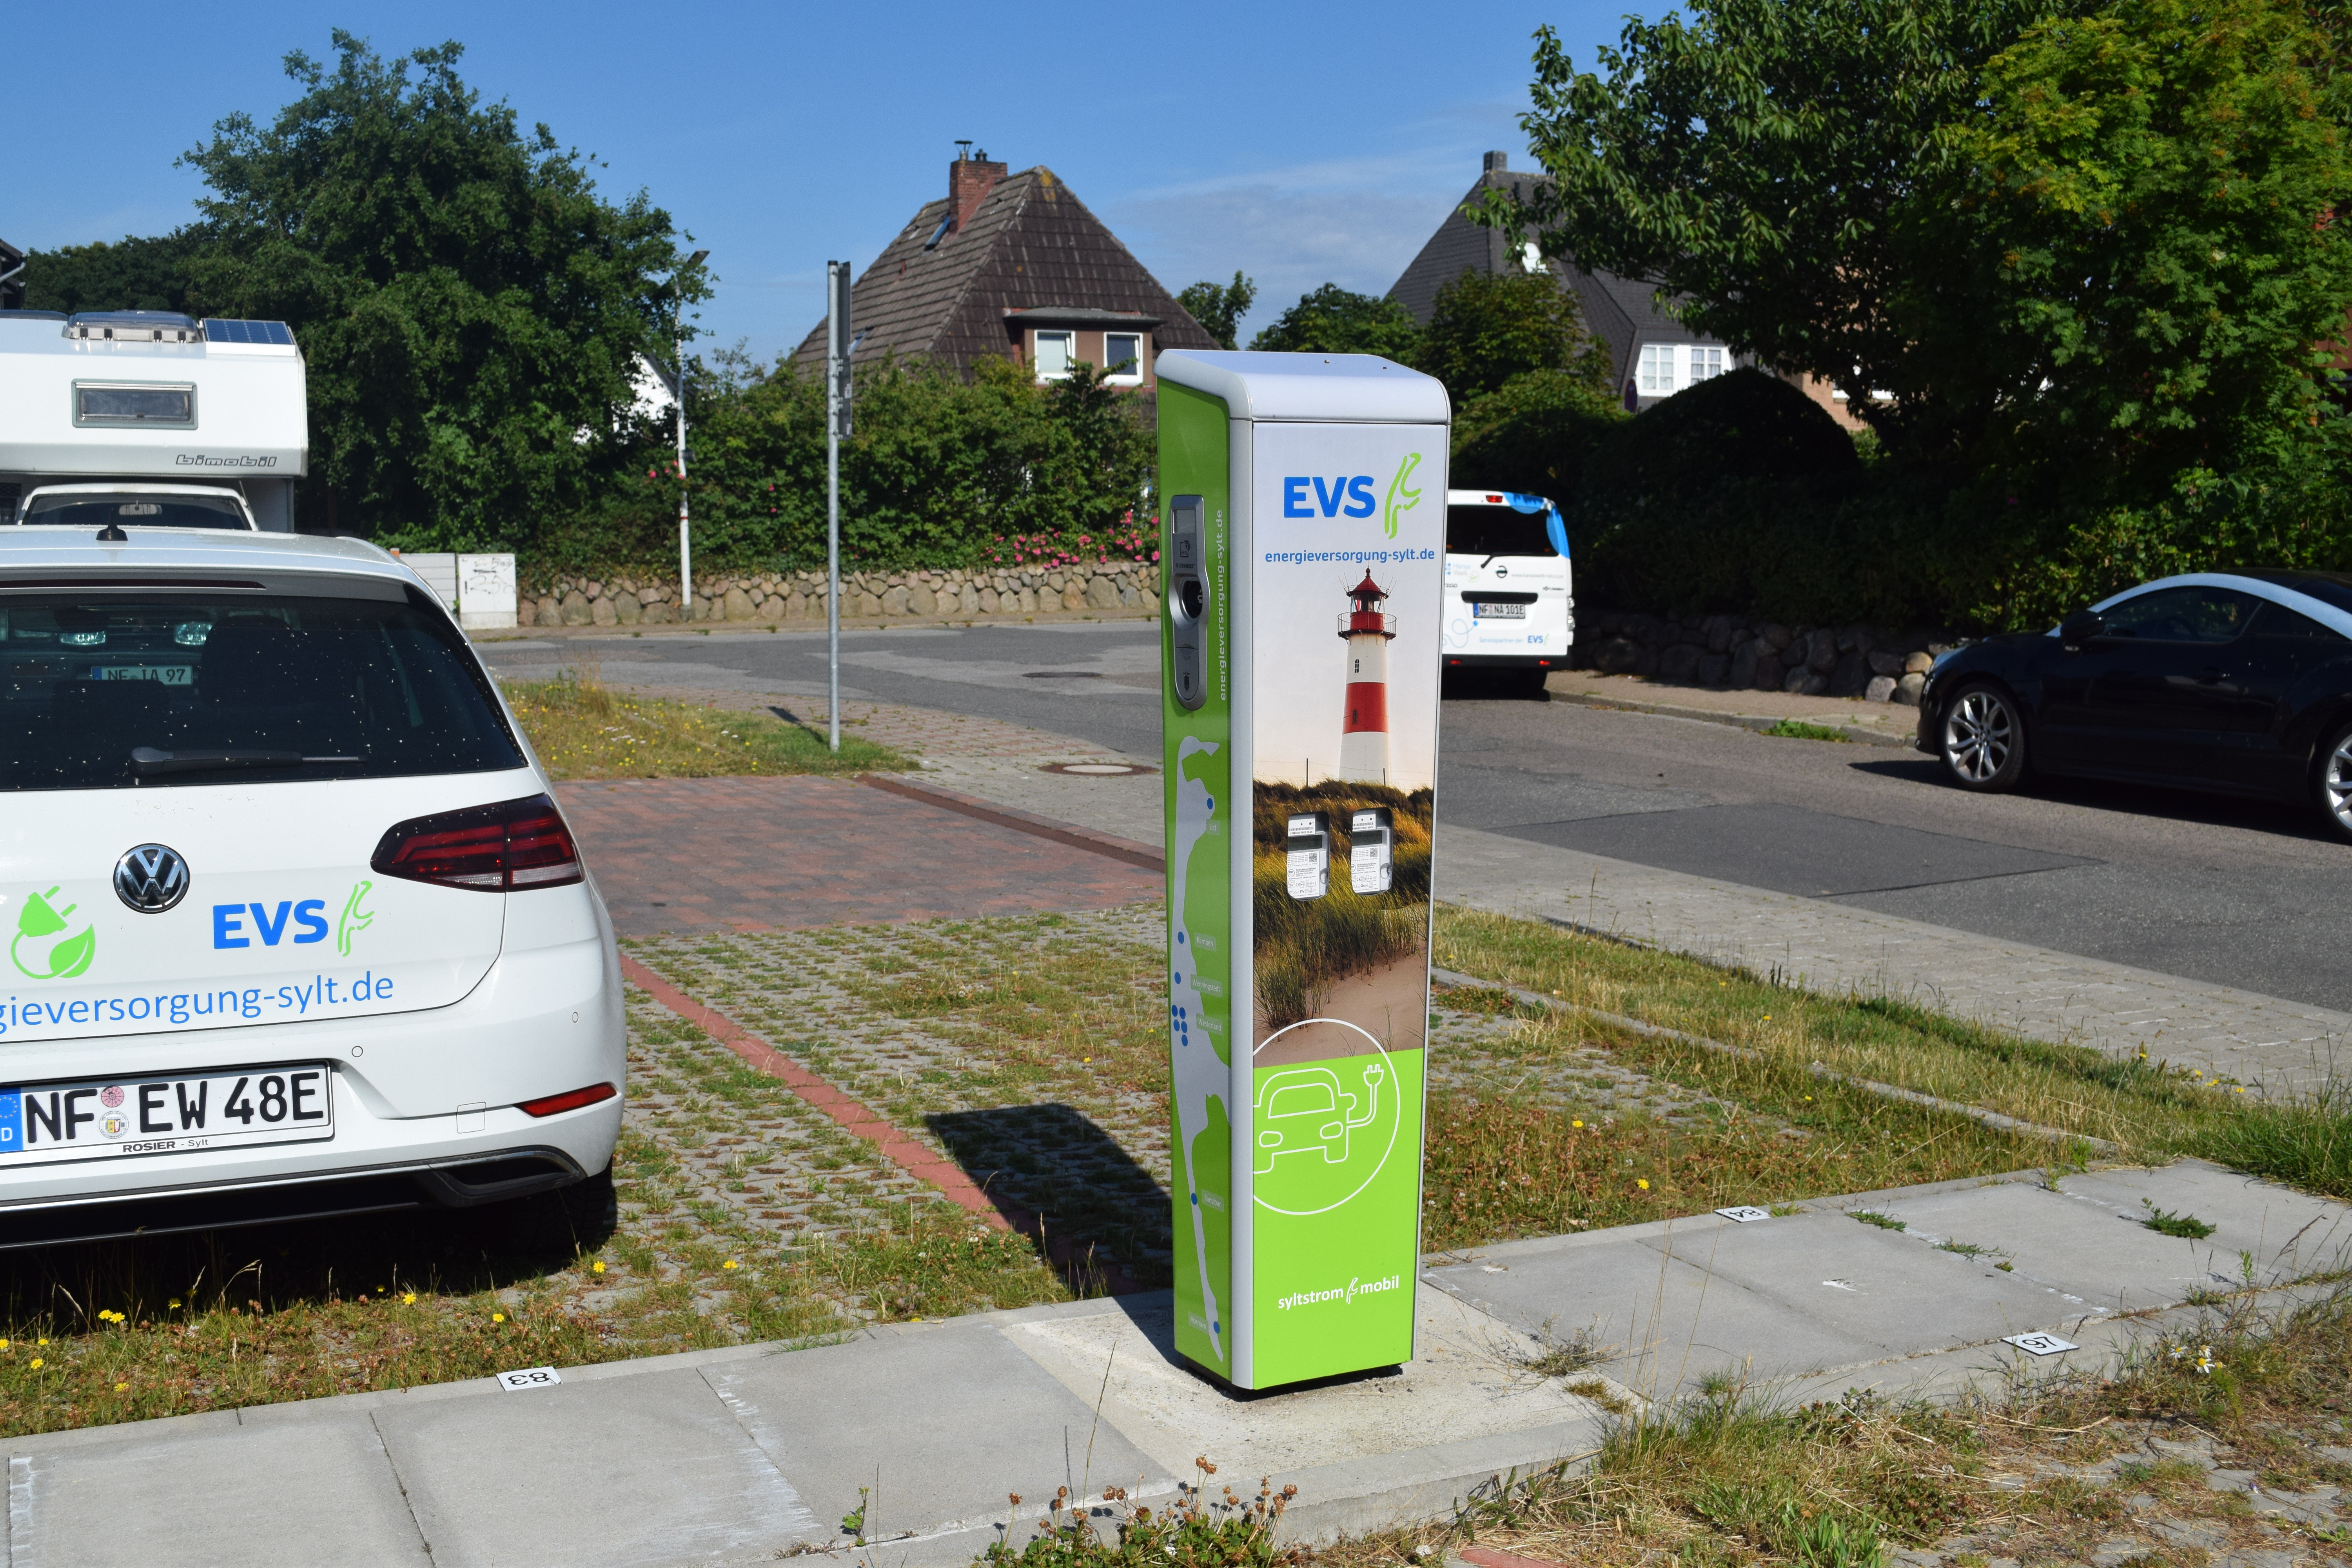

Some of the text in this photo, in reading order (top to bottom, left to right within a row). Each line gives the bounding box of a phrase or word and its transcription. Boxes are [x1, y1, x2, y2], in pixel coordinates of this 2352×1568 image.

[176, 454, 277, 467] bimobil
[1284, 475, 1376, 519] EVS
[1265, 548, 1435, 565] energieversorgung-sylt.de
[1216, 510, 1226, 701] energieversorgung-sylt.de
[1479, 604, 1523, 615] NF NA 101E
[166, 668, 186, 682] 97
[213, 899, 328, 949] EVS
[1197, 937, 1213, 946] Kampen
[1192, 978, 1220, 993] Wenningstedt
[1198, 1018, 1221, 1031] Westerland
[1, 1127, 13, 1141] D
[25, 1089, 98, 1143] NF
[139, 1080, 208, 1133] EW
[224, 1072, 324, 1125] 48E
[123, 1140, 176, 1153] ROSIER
[188, 1138, 209, 1149] Sylt
[1204, 1194, 1221, 1207] Sansibar
[1728, 1209, 1761, 1218] 84
[1278, 1275, 1399, 1310] syltstrom mobil
[1190, 1316, 1206, 1329] Hörnum
[2022, 1336, 2057, 1349] 97
[508, 1372, 550, 1385] 83
